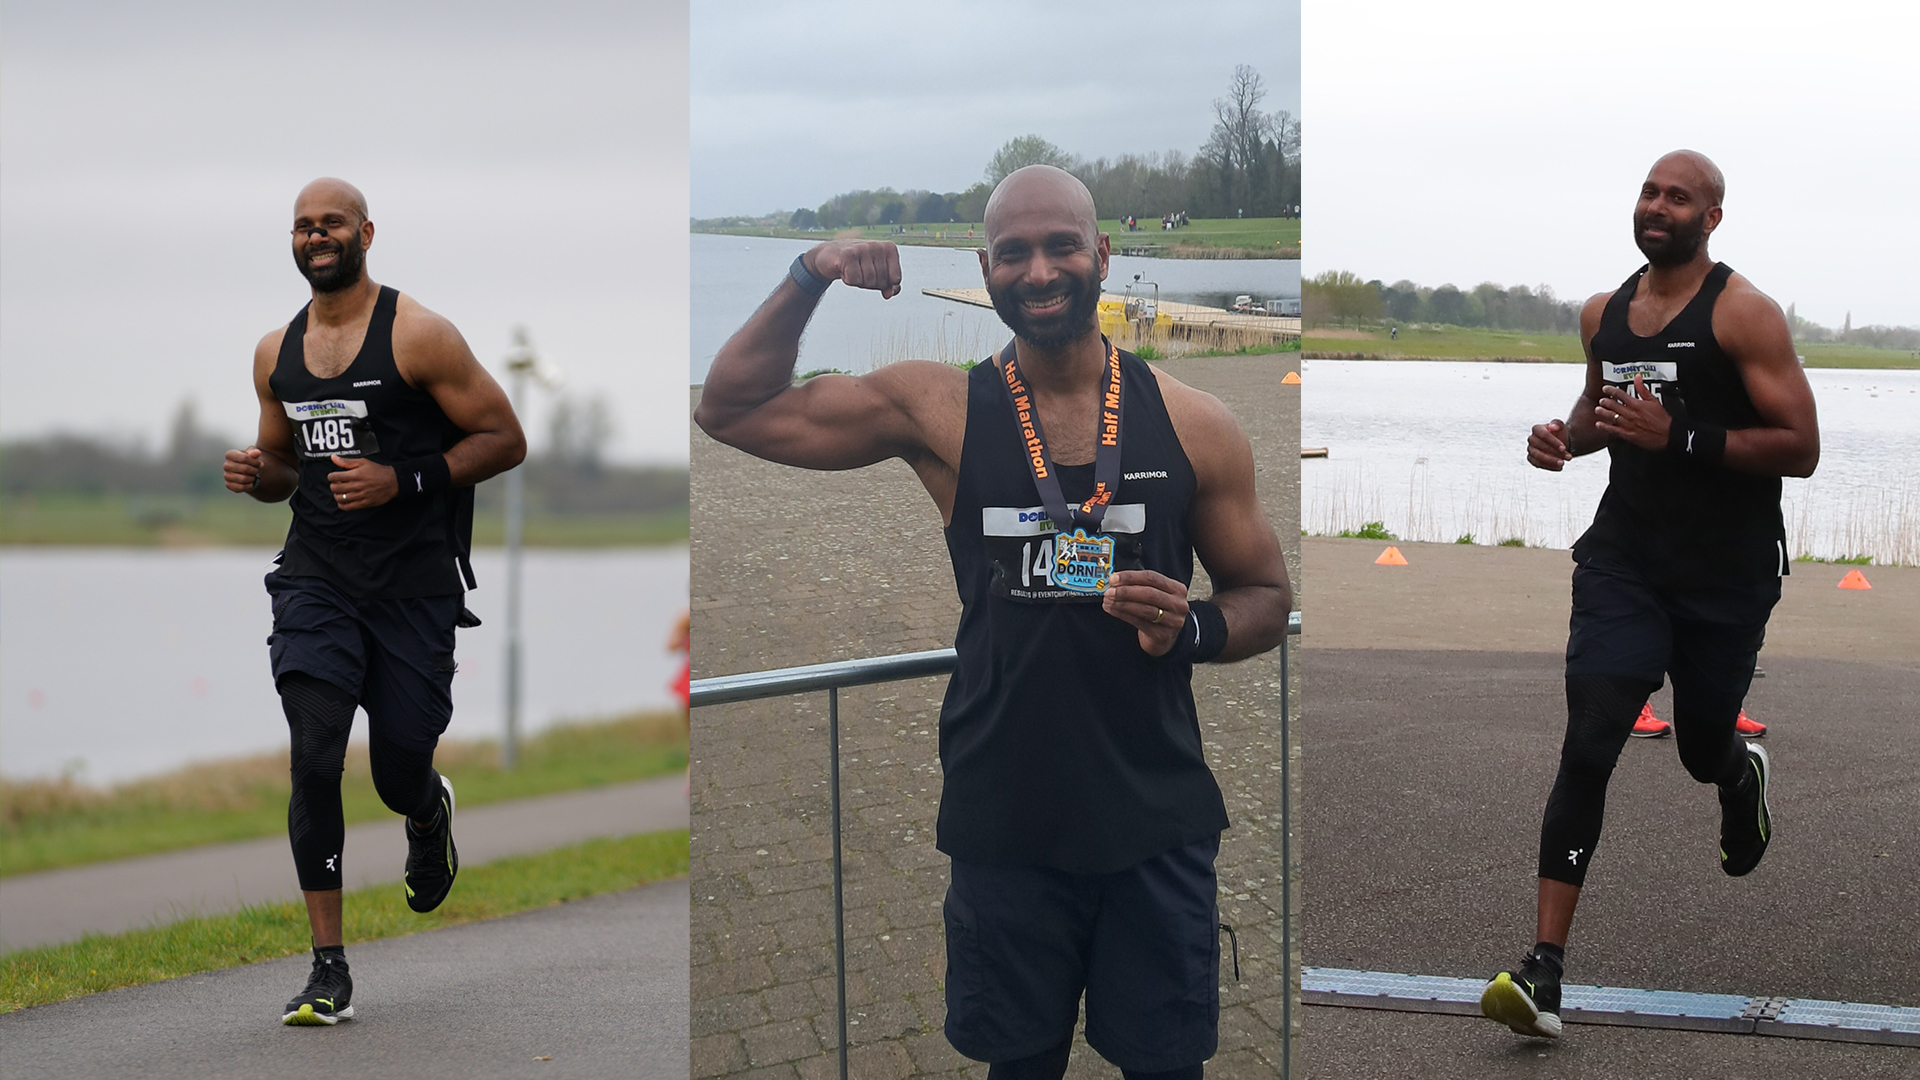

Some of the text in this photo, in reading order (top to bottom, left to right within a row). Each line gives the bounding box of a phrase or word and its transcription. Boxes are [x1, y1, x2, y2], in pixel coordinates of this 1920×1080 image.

[1101, 345, 1121, 446] Half Maratho
[301, 419, 355, 451] 1485
[1003, 360, 1049, 479] Half Marathon
[1124, 471, 1168, 480] KARRIMOR
[1021, 540, 1056, 587] 14
[1057, 563, 1111, 579] DORNEY
[1073, 576, 1093, 585] LAKE
